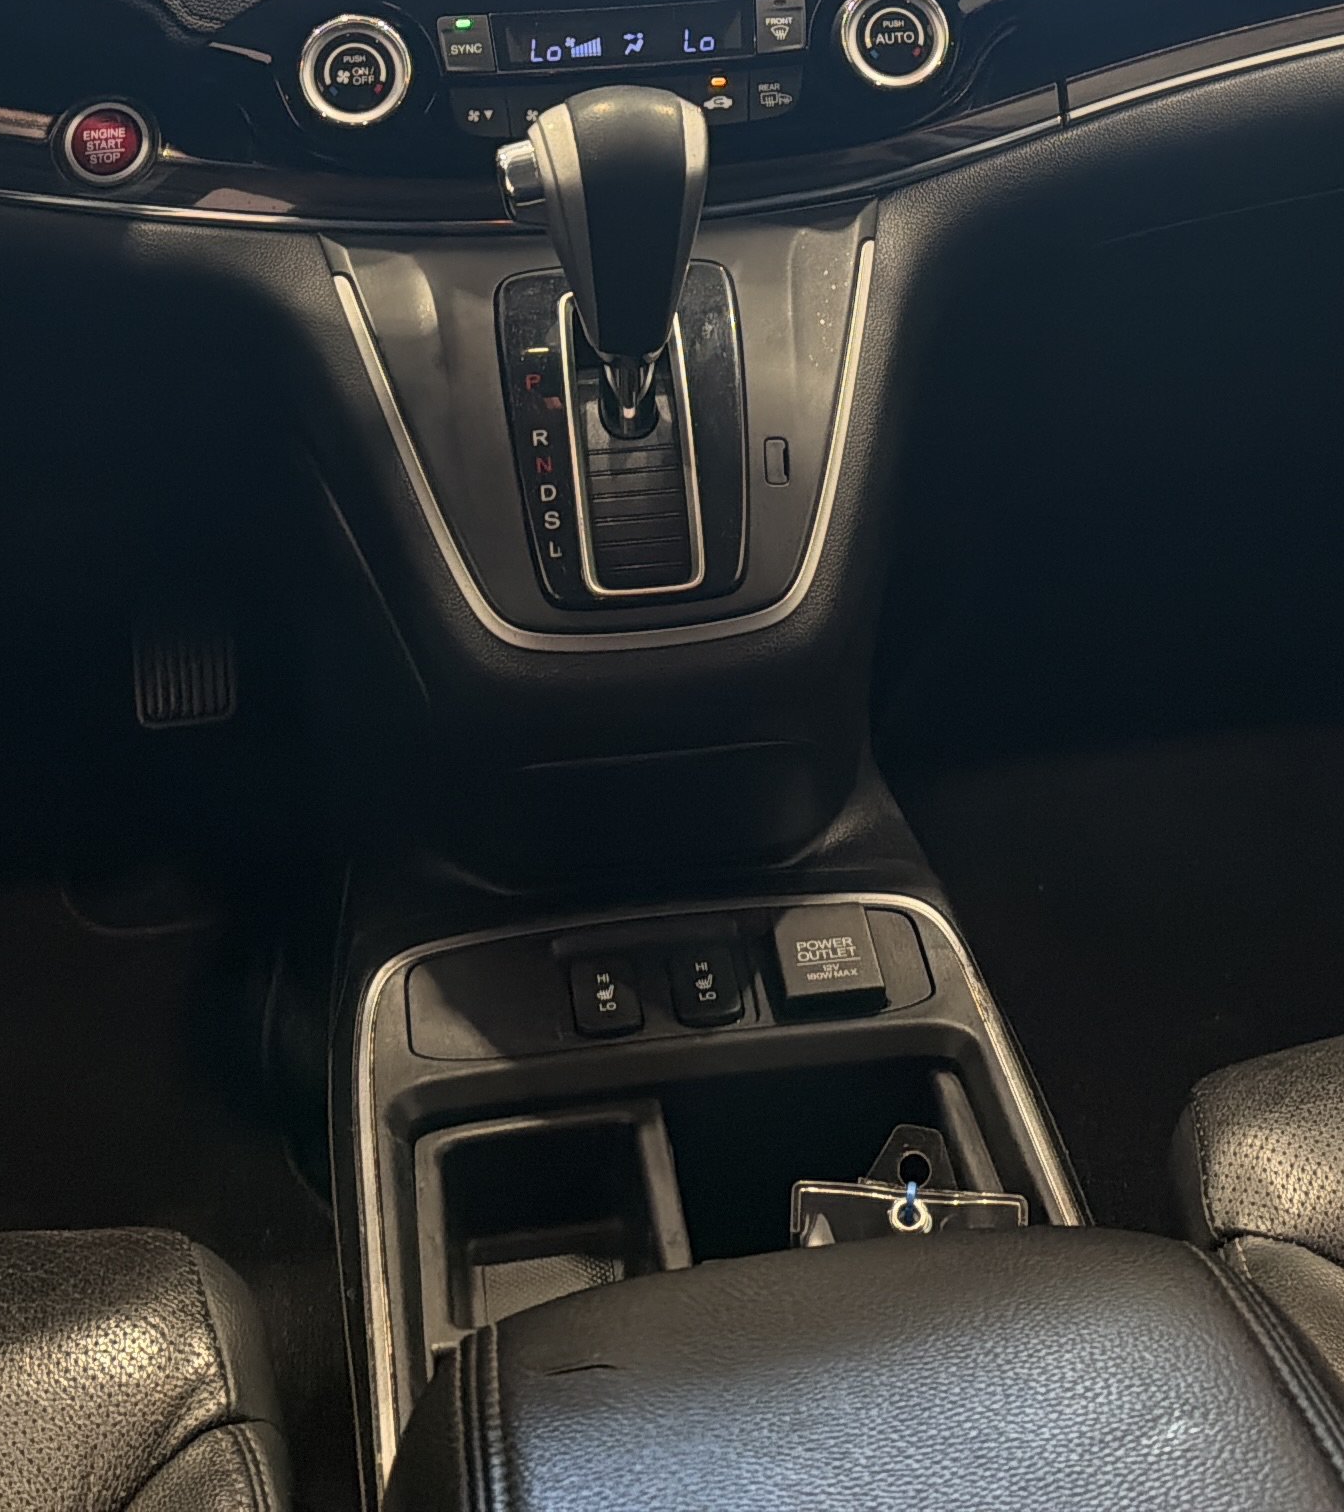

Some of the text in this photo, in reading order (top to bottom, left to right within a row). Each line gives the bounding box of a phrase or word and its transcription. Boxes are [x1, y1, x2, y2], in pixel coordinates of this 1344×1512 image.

[765, 17, 793, 25] FRONT
[882, 20, 904, 28] PUSH
[876, 32, 915, 45] AUTO
[450, 43, 482, 55] SYNC
[530, 29, 715, 63] Lo Lo
[343, 54, 366, 64] PUSH
[353, 76, 374, 85] OFF
[758, 83, 780, 91] REAR
[83, 127, 126, 141] ENGINE
[86, 138, 124, 151] START
[90, 152, 121, 164] STOP
[525, 374, 541, 390] P
[532, 429, 548, 446] R
[536, 456, 552, 473] N
[540, 484, 557, 502] D
[544, 511, 561, 529] S
[549, 541, 563, 558] L
[796, 937, 853, 952] POWER
[797, 945, 856, 961] OUTLET
[695, 962, 708, 972] HI
[596, 973, 610, 984] HI
[699, 991, 717, 1001] LO
[599, 1002, 617, 1012] LO
